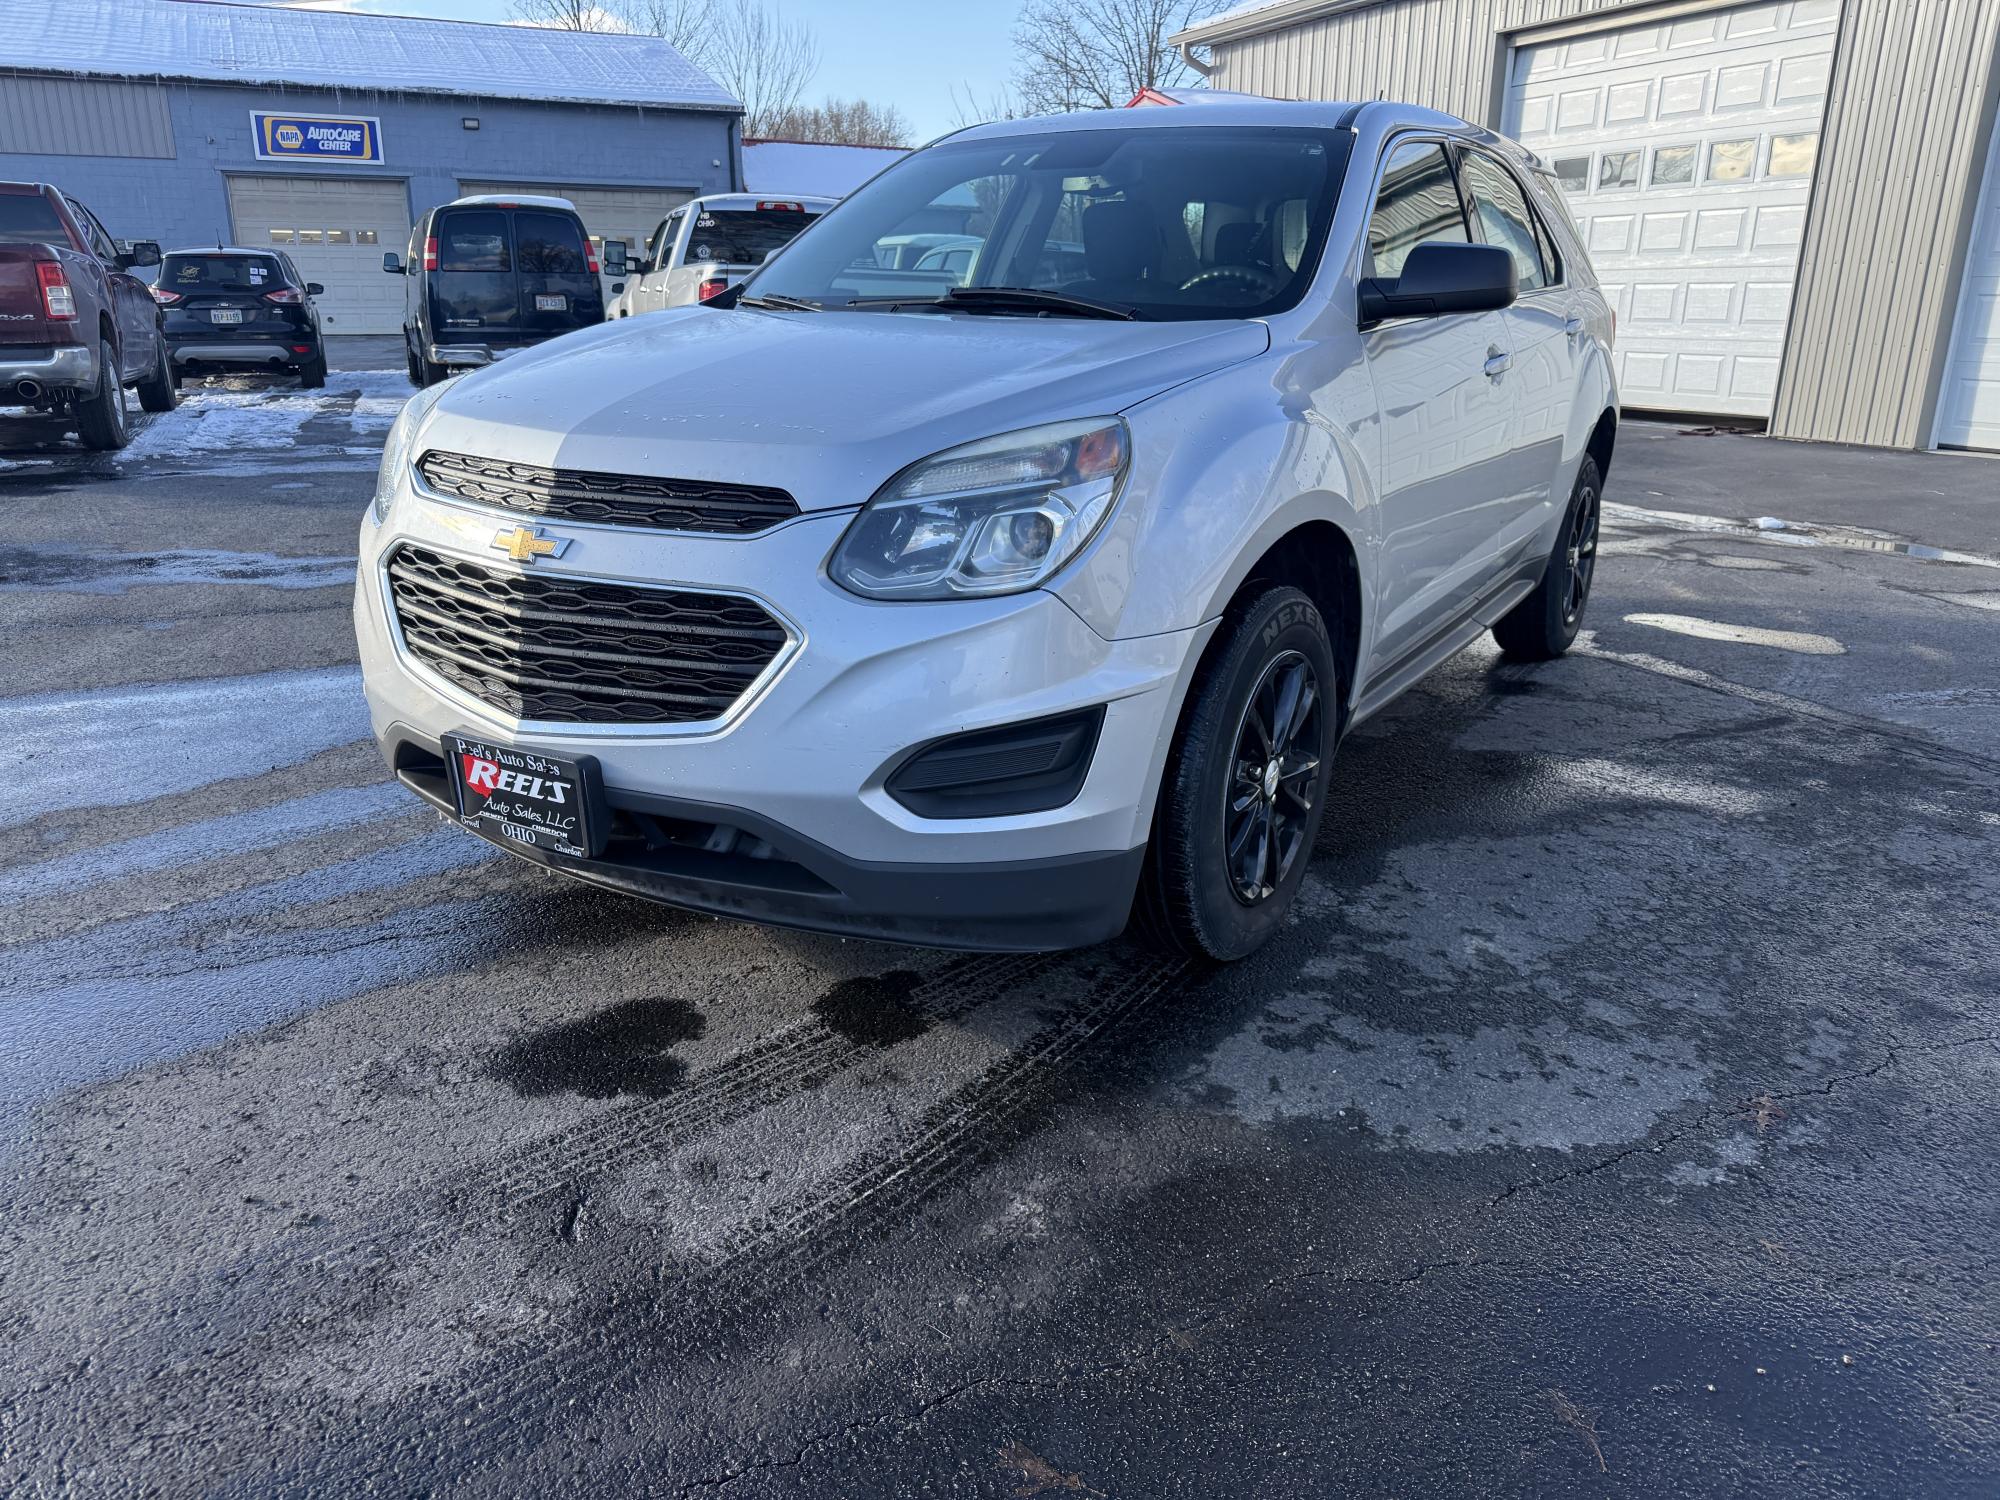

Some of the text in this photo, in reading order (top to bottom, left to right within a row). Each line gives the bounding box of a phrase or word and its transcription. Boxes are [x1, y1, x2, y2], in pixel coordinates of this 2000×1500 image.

[280, 130, 300, 143] NAPA
[318, 141, 352, 151] CENTER
[697, 219, 716, 228] OHIO
[701, 212, 710, 220] HB
[494, 748, 525, 768] Auto
[467, 758, 571, 804] REEL'S
[483, 796, 576, 830] Auto Sales, LLC
[501, 823, 536, 844] OHIO
[554, 843, 583, 858] Chardon
